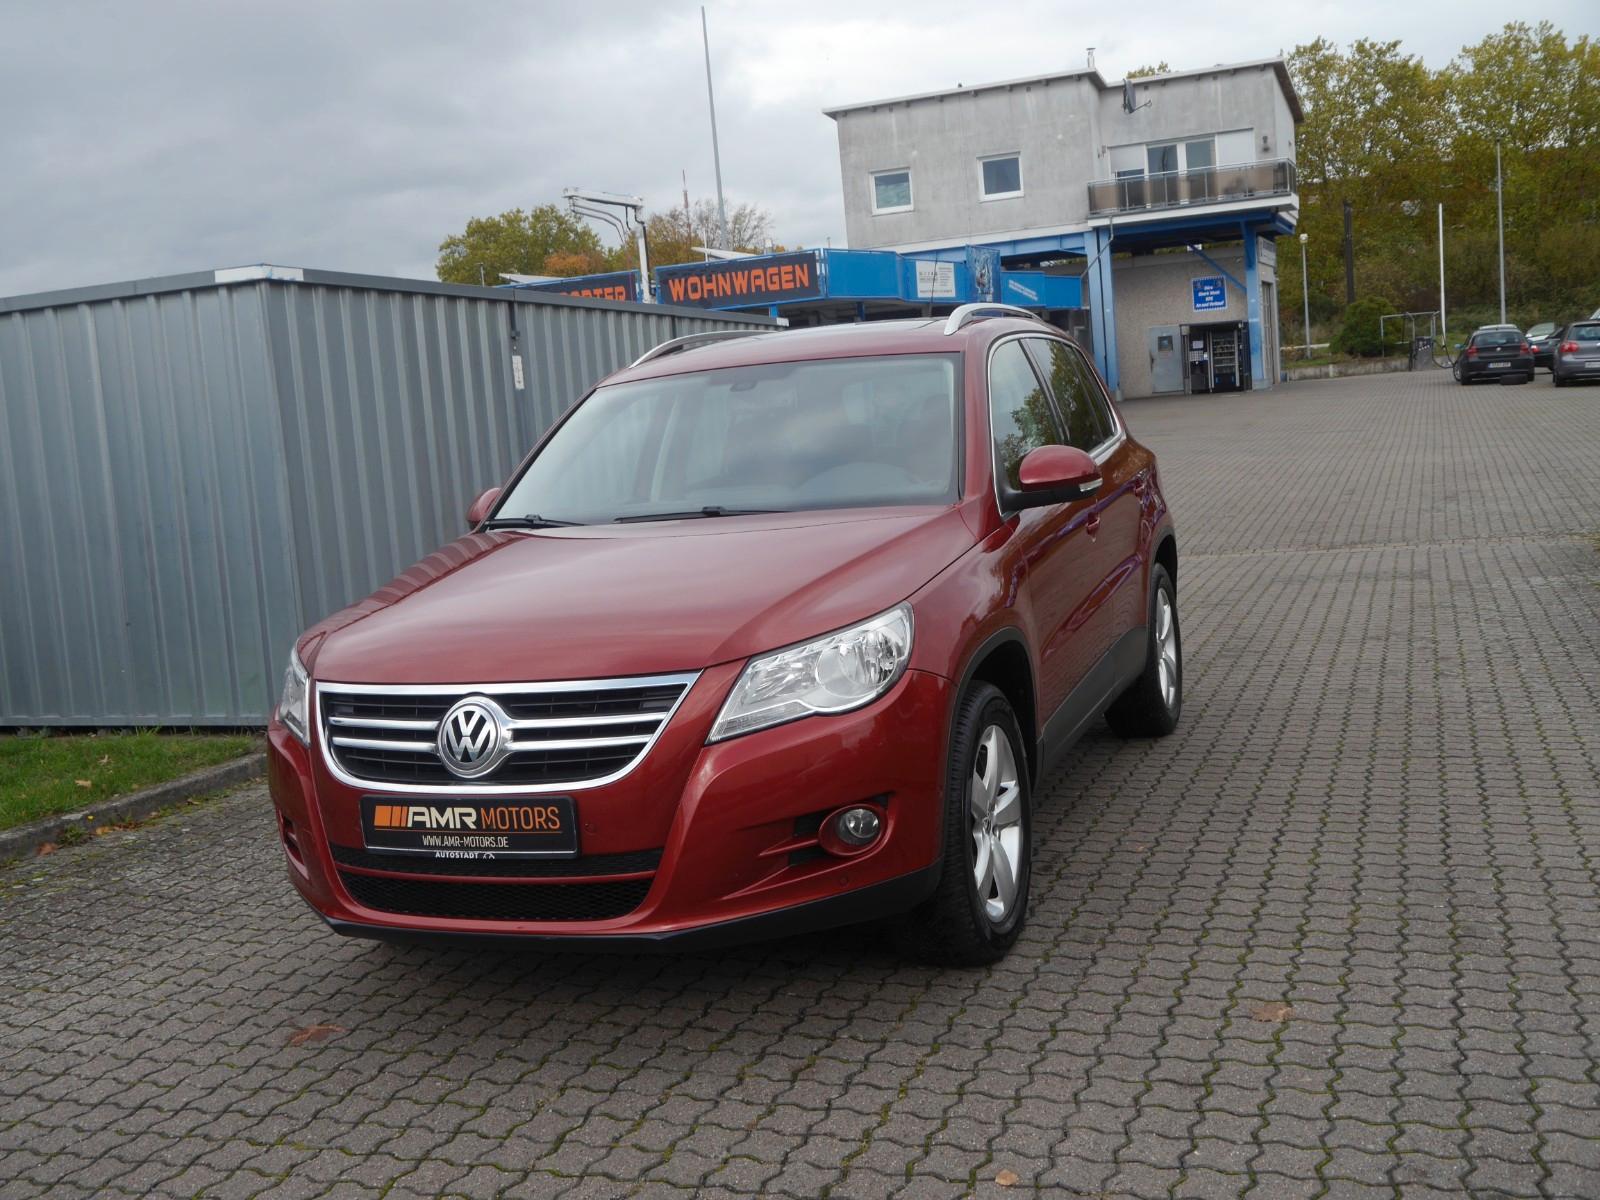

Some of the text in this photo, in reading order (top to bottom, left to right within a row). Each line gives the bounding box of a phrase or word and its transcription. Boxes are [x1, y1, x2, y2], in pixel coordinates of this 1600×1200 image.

[668, 263, 810, 303] WOHNWAGEN
[407, 806, 560, 830] AMR MOTORS
[422, 835, 509, 849] WWW.AMR-MOTORS.DE
[435, 850, 479, 859] AUTOSTADT
